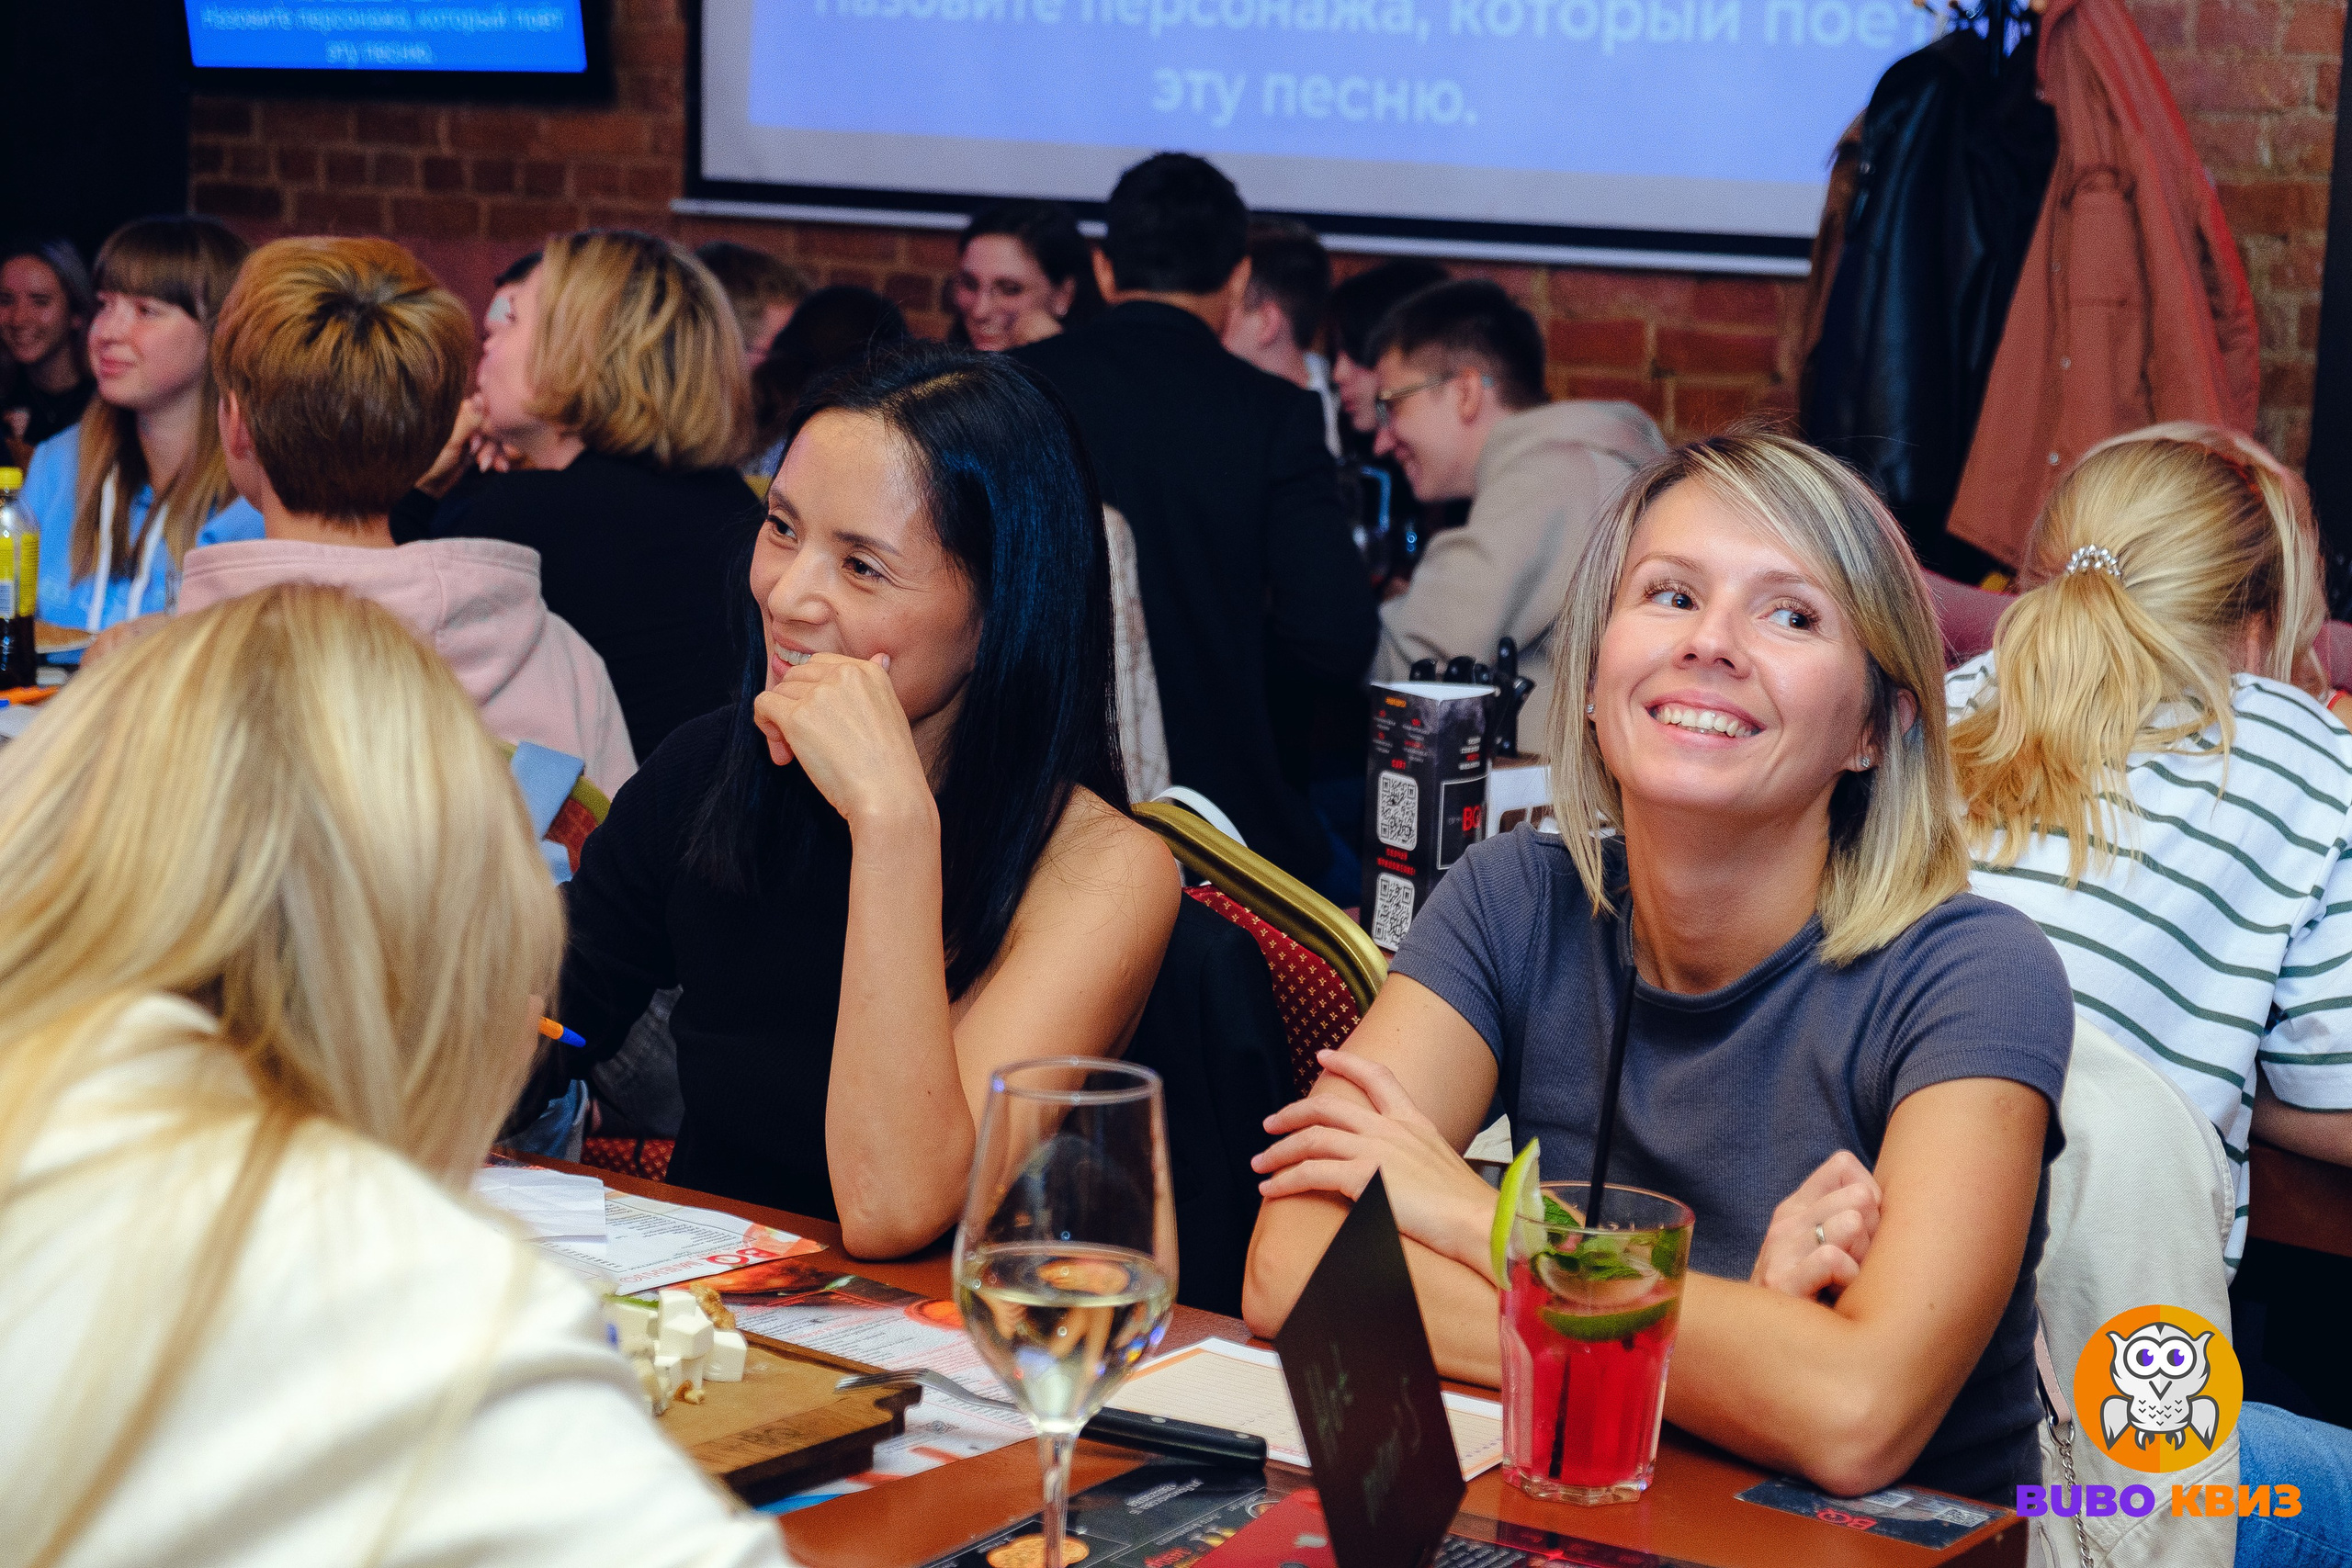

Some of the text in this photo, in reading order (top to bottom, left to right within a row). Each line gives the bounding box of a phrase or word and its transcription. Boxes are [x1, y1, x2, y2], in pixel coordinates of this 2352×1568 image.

[1080, 0, 1430, 43] персонажа,
[1451, 0, 1740, 55] который
[1152, 67, 1477, 129] эту песню.
